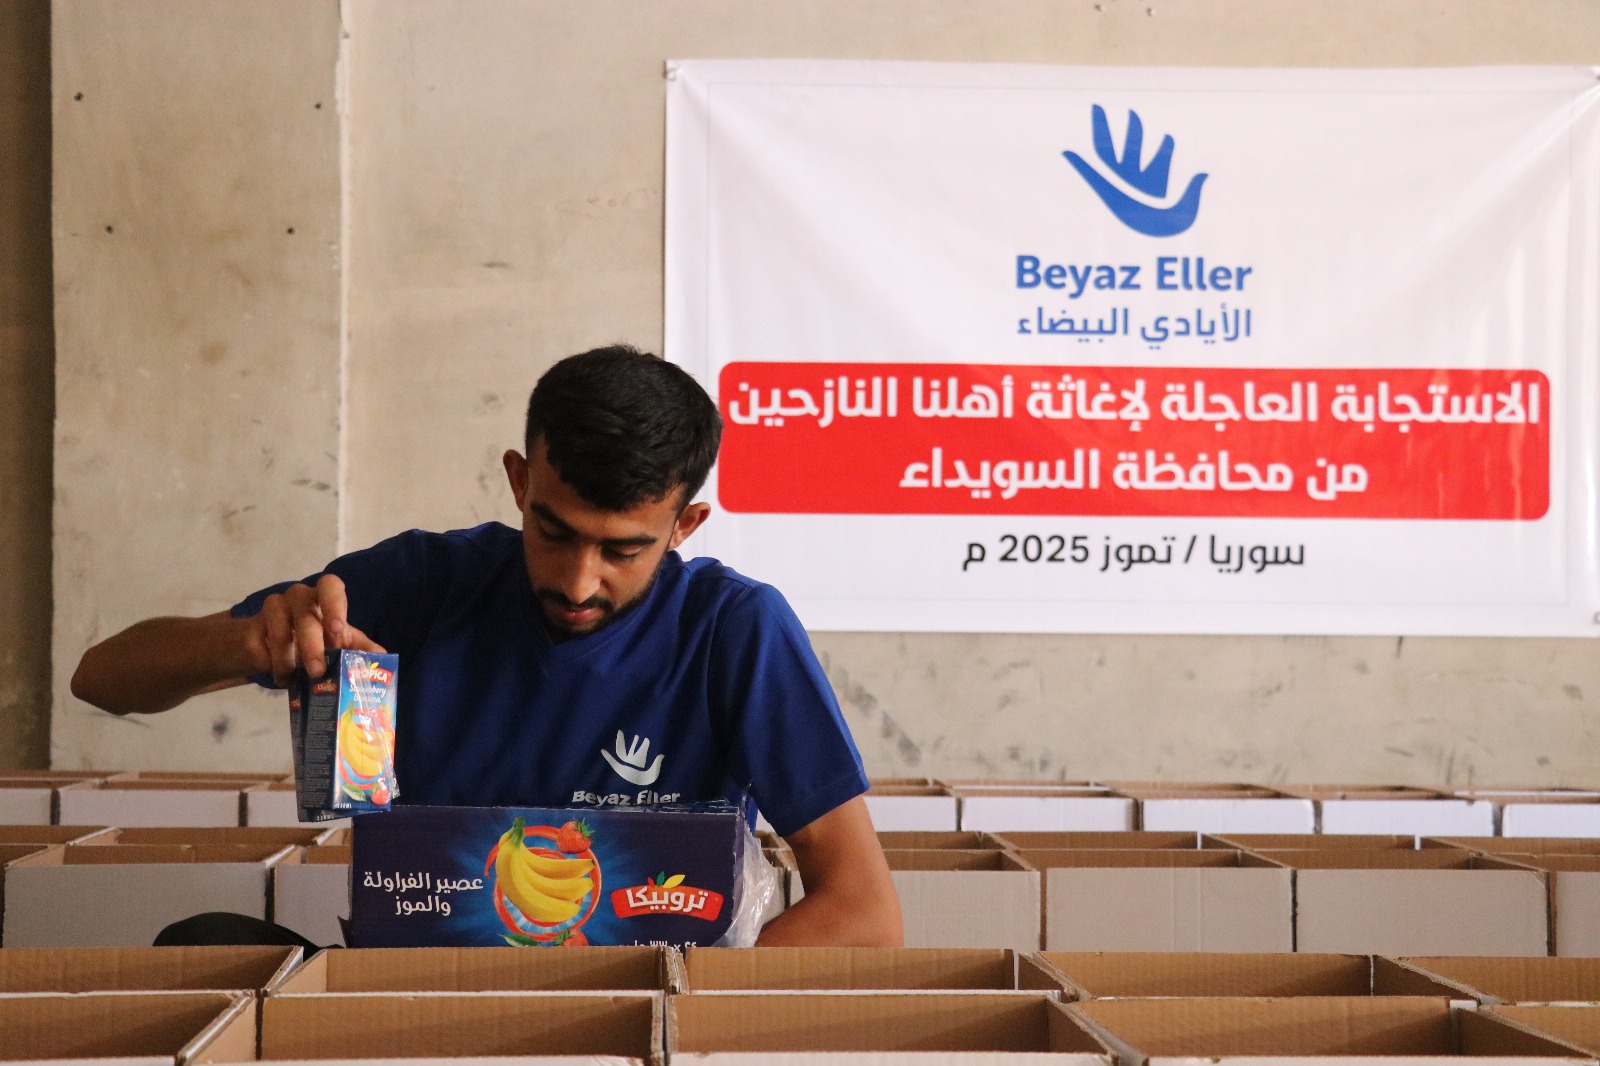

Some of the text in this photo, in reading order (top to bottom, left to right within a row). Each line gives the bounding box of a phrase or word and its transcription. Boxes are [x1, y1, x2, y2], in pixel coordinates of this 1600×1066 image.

[1016, 255, 1252, 299] Beyaz Eller
[1017, 303, 1251, 350] الأيادي البيضاء
[729, 374, 1540, 433] الاستجابة العاجلة لإغاثة أهلنا النازحين
[899, 447, 1368, 501] من محافظة السويداء
[962, 534, 1305, 573] سوريا / تموز 2025 م
[572, 789, 681, 807] Beyaz Eller
[363, 871, 484, 894] عصير الفراولة
[625, 885, 709, 912] تروبيكا
[395, 894, 452, 916] والموز
